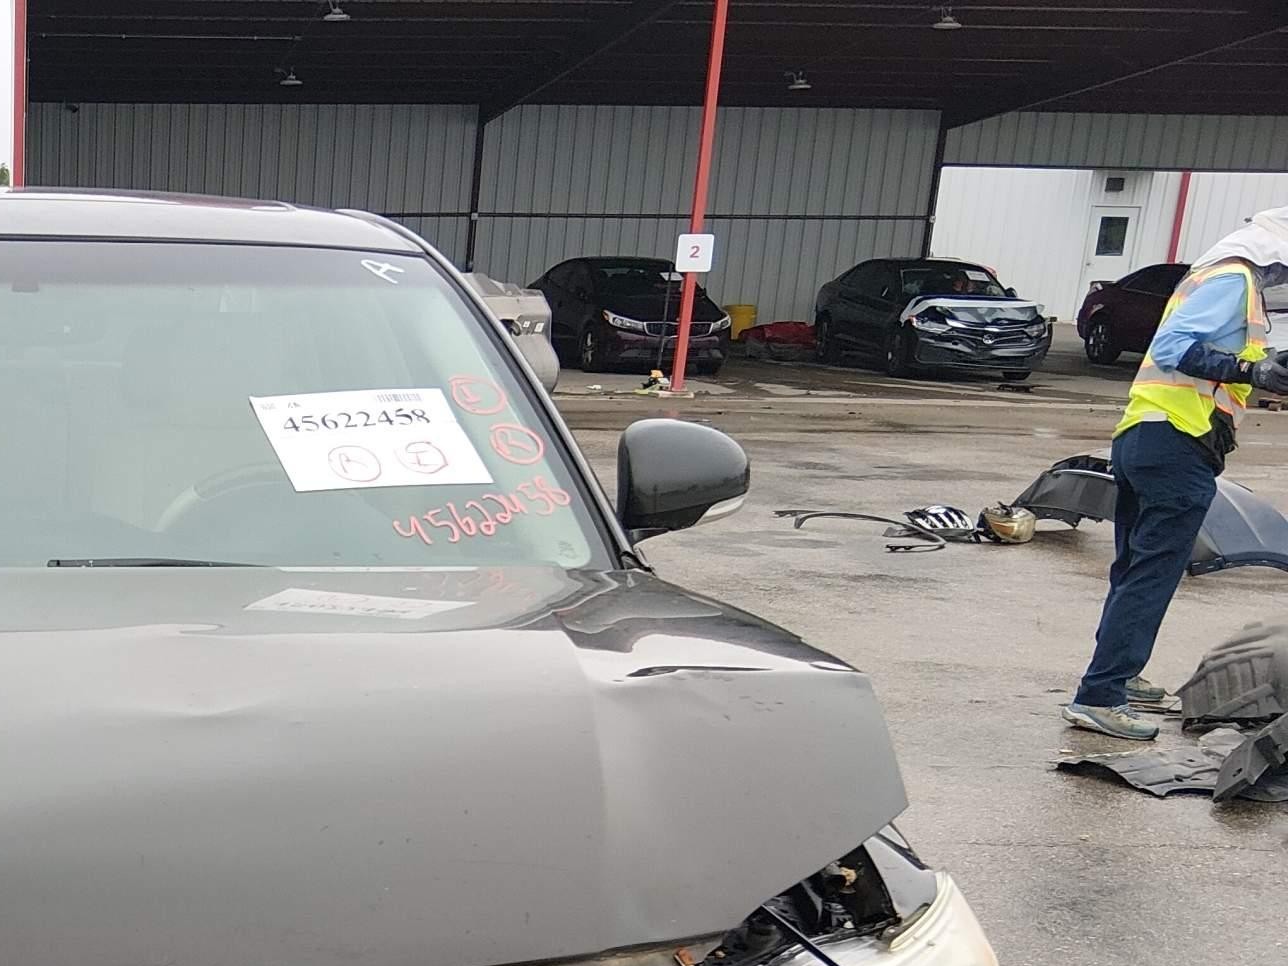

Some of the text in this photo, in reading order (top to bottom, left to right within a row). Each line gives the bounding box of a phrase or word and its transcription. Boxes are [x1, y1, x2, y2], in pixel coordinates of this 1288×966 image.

[689, 245, 700, 259] 2
[283, 407, 431, 432] 45622458
[392, 475, 571, 545] 45622458
